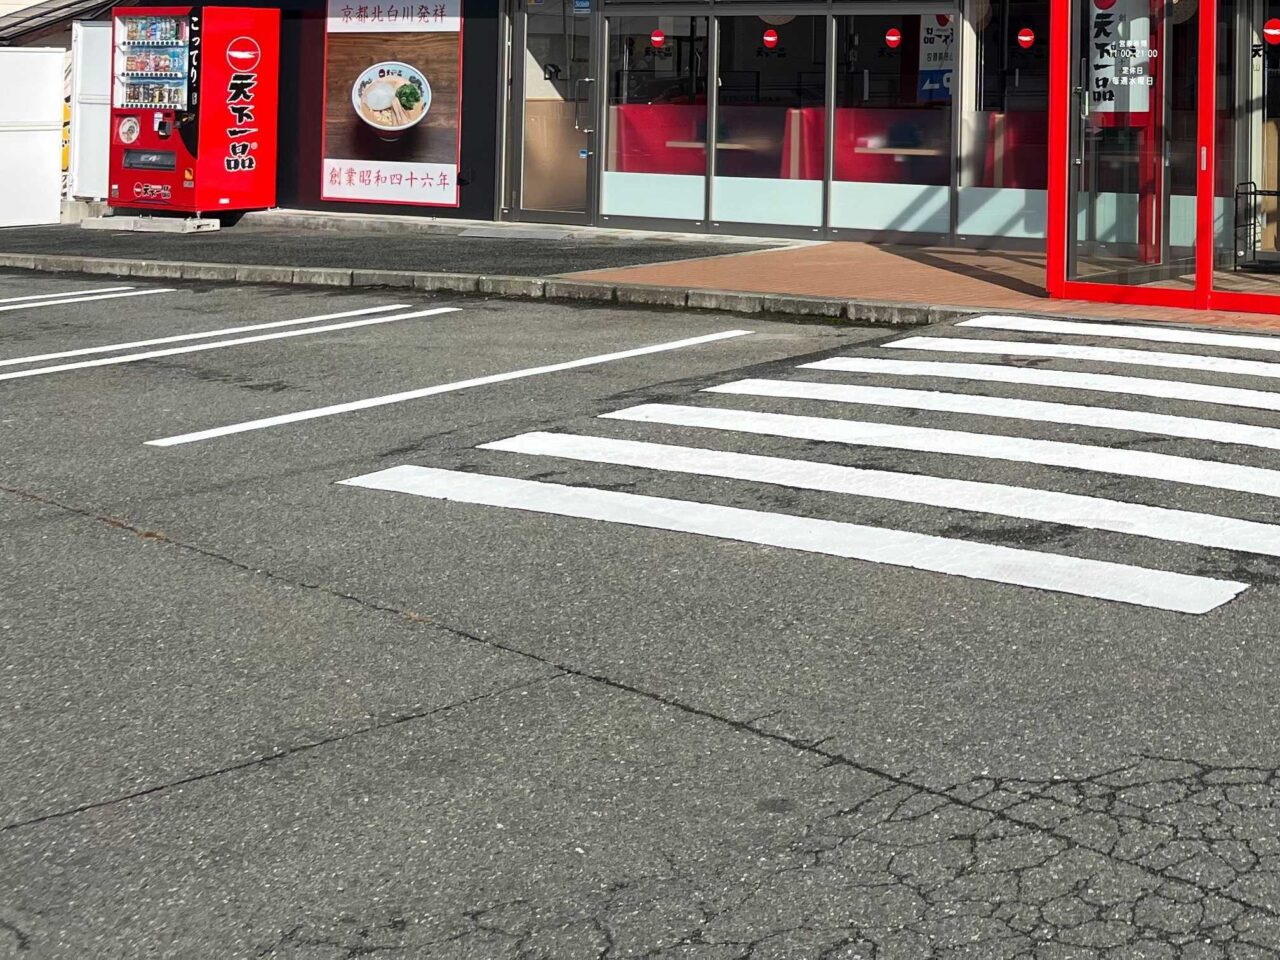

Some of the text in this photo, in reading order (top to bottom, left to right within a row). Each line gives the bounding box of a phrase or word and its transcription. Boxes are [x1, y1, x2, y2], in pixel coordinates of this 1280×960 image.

[341, 4, 447, 24] 京都北白川発祥
[1092, 13, 1116, 103] 天下一品
[225, 72, 258, 172] 天下一品
[328, 167, 450, 192] 創業昭和四十六年
